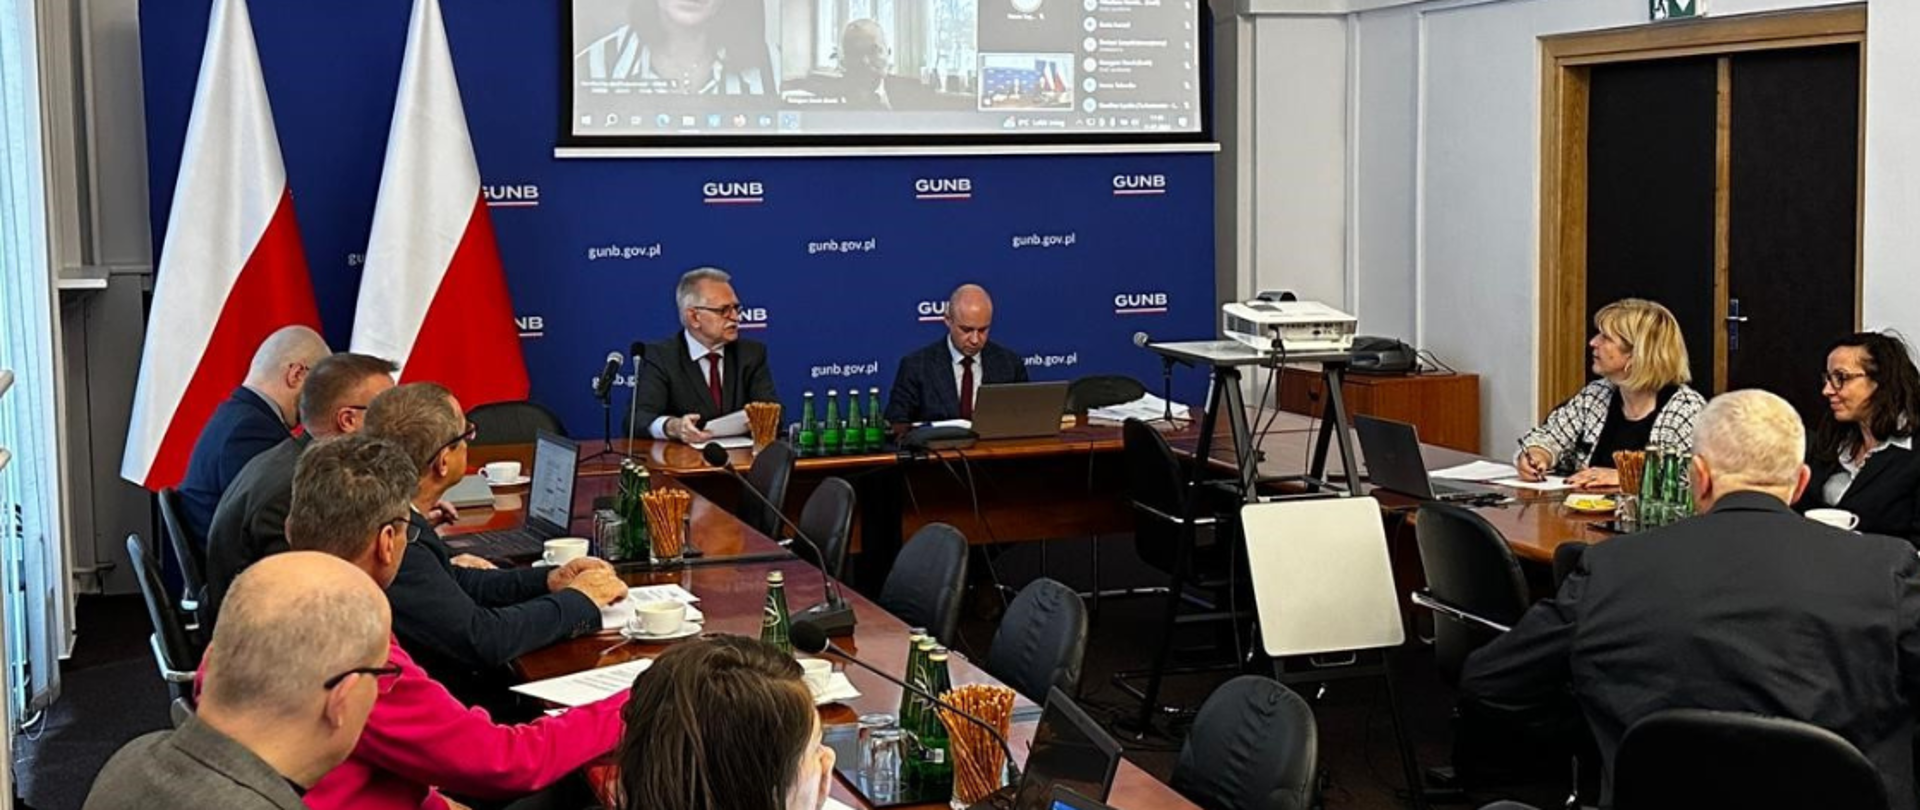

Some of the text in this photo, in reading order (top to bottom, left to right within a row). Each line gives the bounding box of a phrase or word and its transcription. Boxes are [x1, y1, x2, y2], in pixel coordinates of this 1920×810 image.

[915, 178, 972, 193] GUNB
[1113, 174, 1166, 188] GUNB
[703, 182, 763, 197] GUNB
[808, 238, 876, 254] gunb.gov.pl
[1012, 232, 1076, 248] gunb.gov.pl
[588, 243, 661, 260] gunb.gov.pl
[1114, 293, 1168, 307] GUNB
[811, 360, 878, 377] gunb.gov.pl
